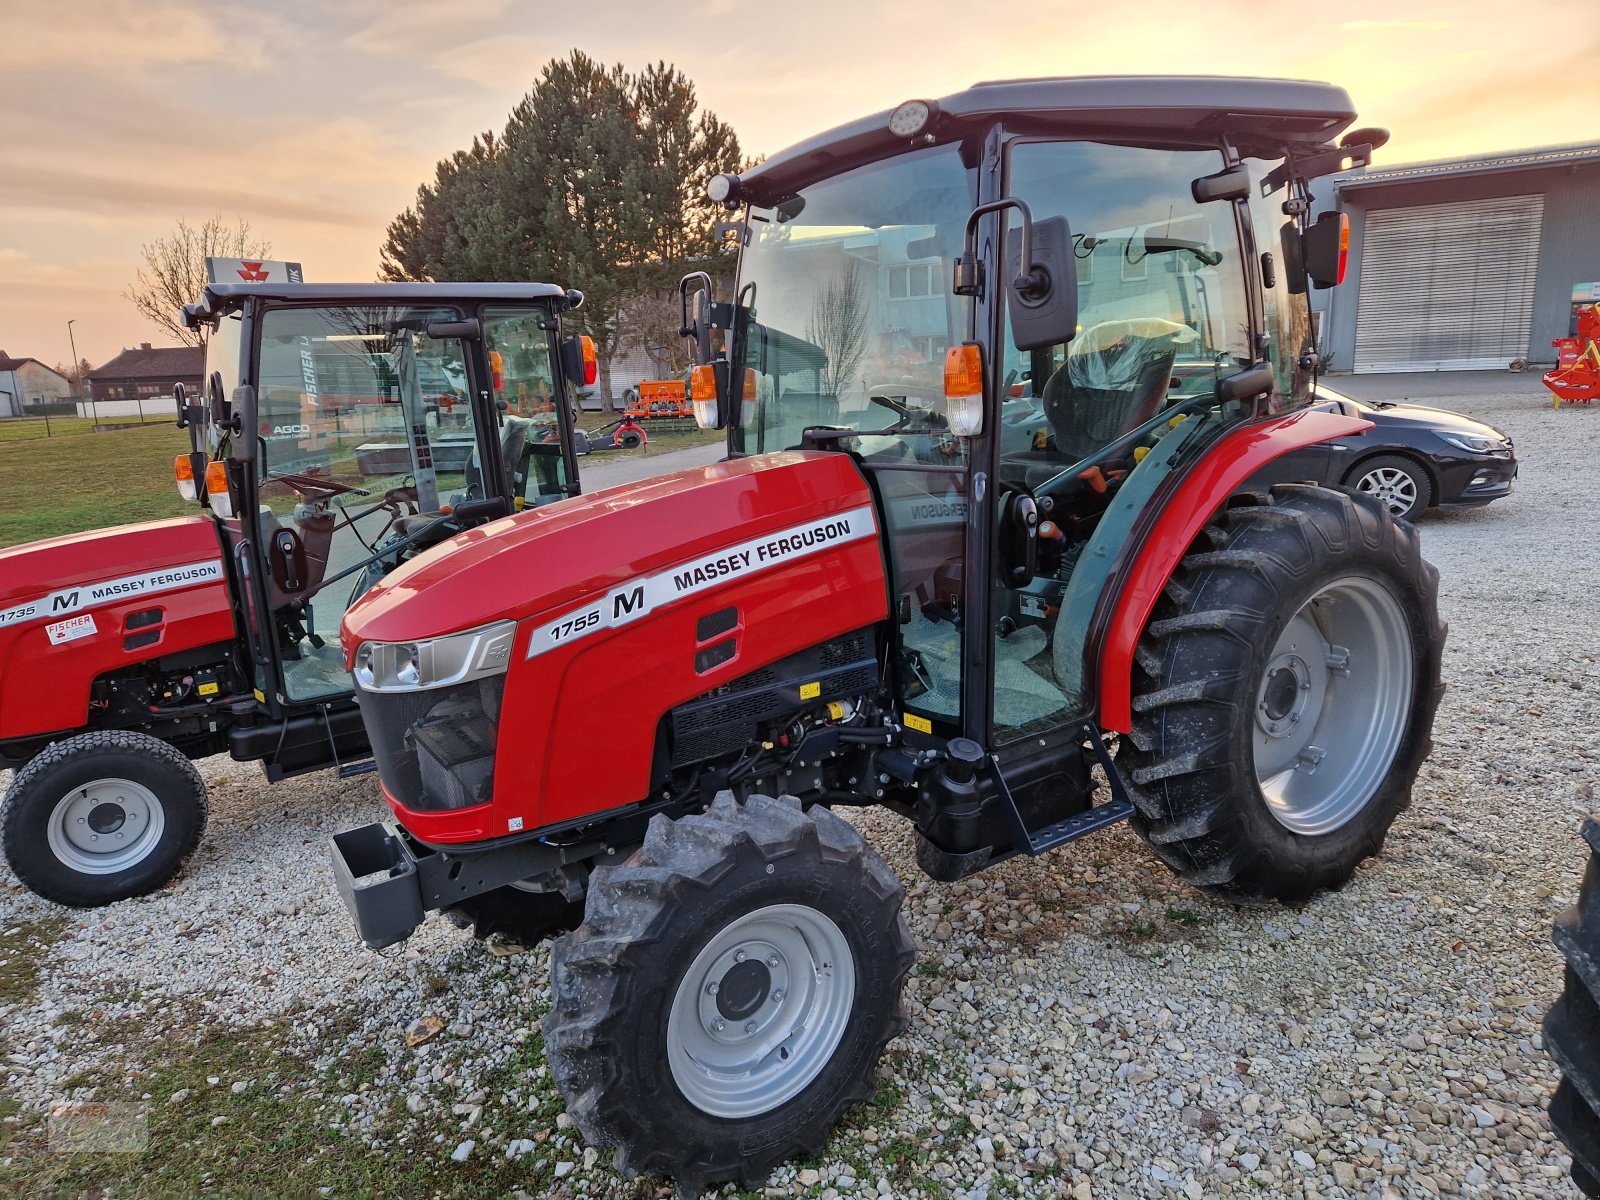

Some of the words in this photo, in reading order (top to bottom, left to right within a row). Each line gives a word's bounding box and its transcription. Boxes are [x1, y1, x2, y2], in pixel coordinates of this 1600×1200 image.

[301, 350, 319, 406] FISCHER
[274, 424, 310, 434] AGCO
[0, 606, 36, 623] 1735
[52, 591, 79, 612] M
[92, 579, 146, 599] MASSEY
[150, 566, 217, 586] FERGUSON
[550, 610, 600, 641] 1755
[612, 585, 645, 619] M
[673, 550, 751, 591] MASSEY
[756, 519, 851, 562] FERGUSON
[49, 615, 91, 634] FISCHER
